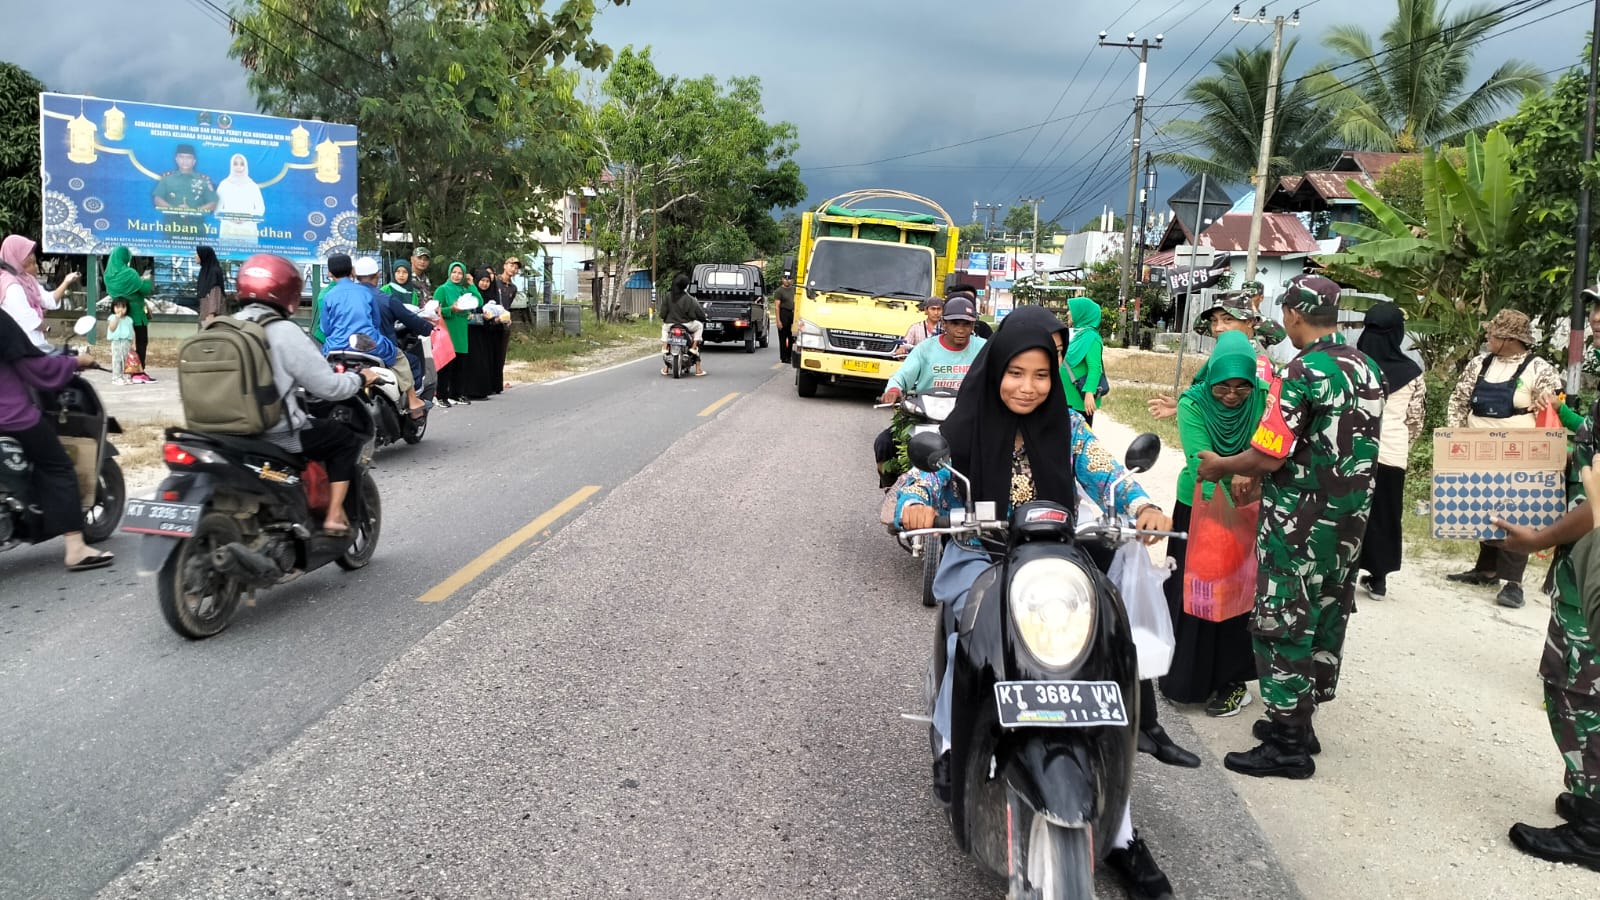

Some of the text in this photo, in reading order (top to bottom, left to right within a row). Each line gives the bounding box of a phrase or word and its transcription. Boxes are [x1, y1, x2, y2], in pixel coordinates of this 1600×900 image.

[127, 218, 198, 234] Marhaban
[202, 223, 218, 235] Ya
[1170, 268, 1207, 281] NATON
[1514, 471, 1556, 487] Orig
[127, 503, 144, 517] KT
[1000, 685, 1118, 704] KT 3684 VW
